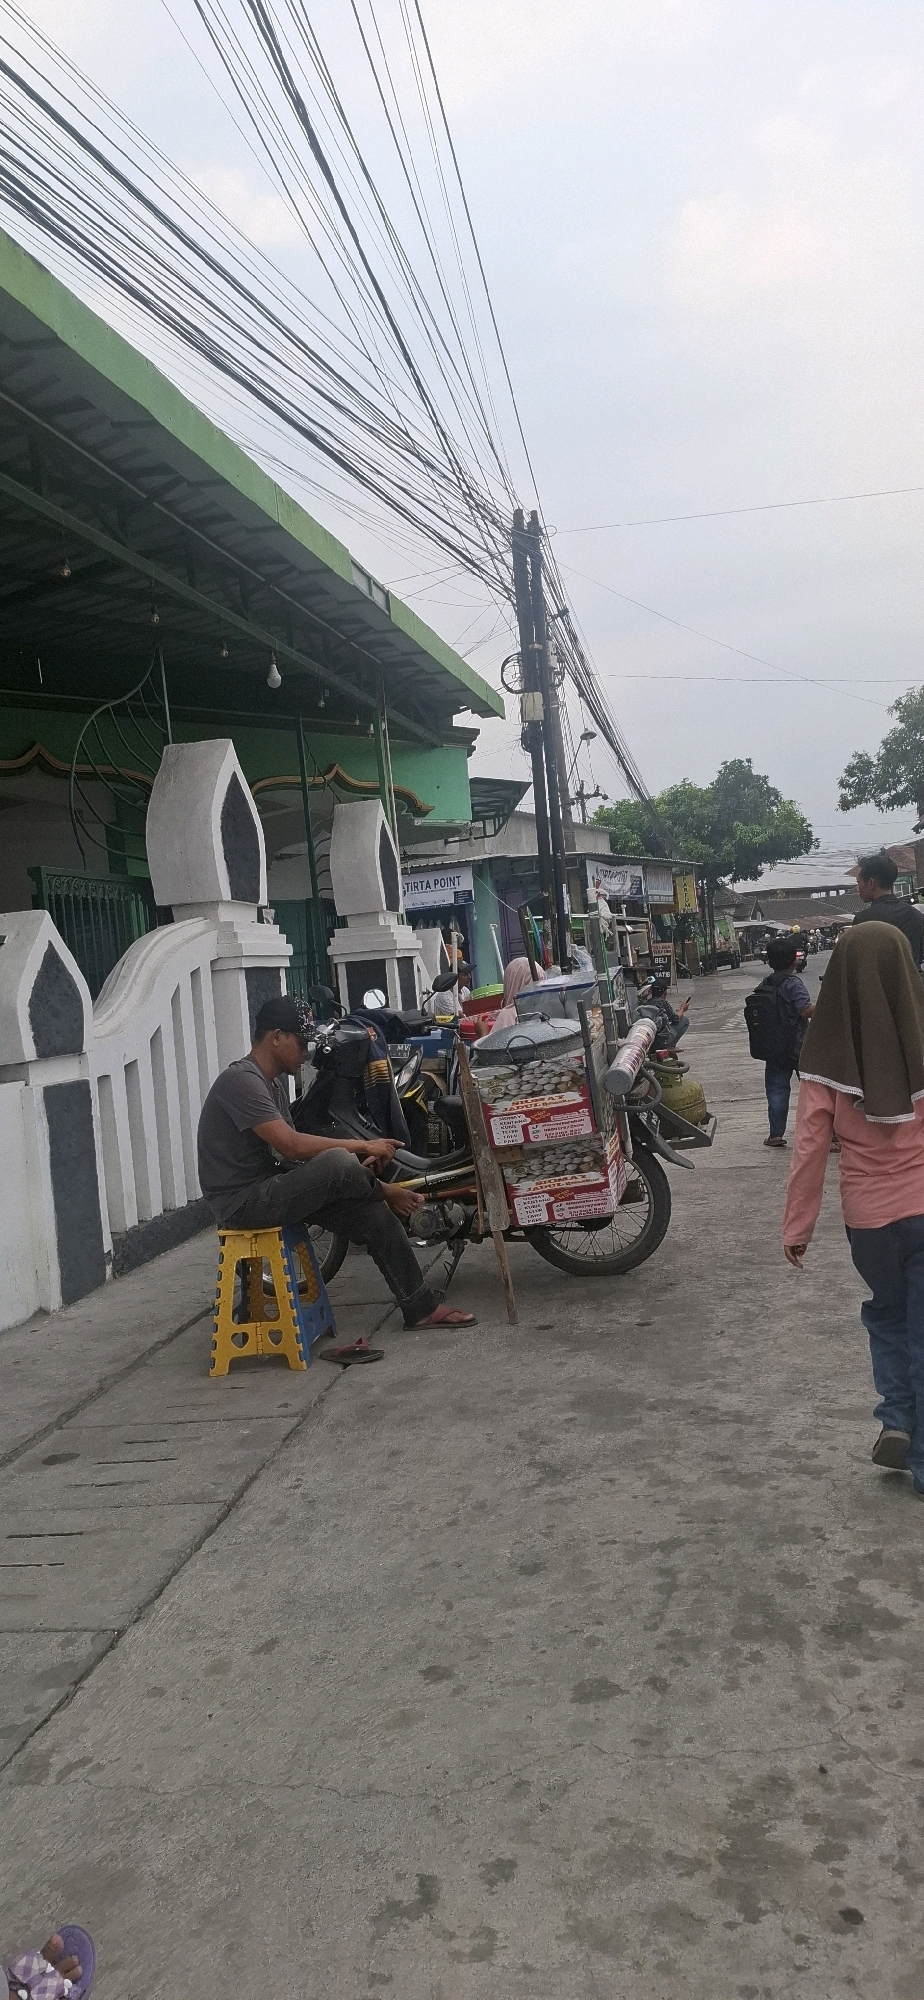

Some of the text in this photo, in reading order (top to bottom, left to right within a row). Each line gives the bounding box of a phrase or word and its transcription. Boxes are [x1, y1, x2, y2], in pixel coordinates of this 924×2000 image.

[405, 880, 431, 892] TIRTA
[434, 875, 462, 889] POINT
[683, 877, 691, 908] PARFUM
[511, 1094, 564, 1106] SIOMAY
[535, 1174, 587, 1185] SIOMAY
